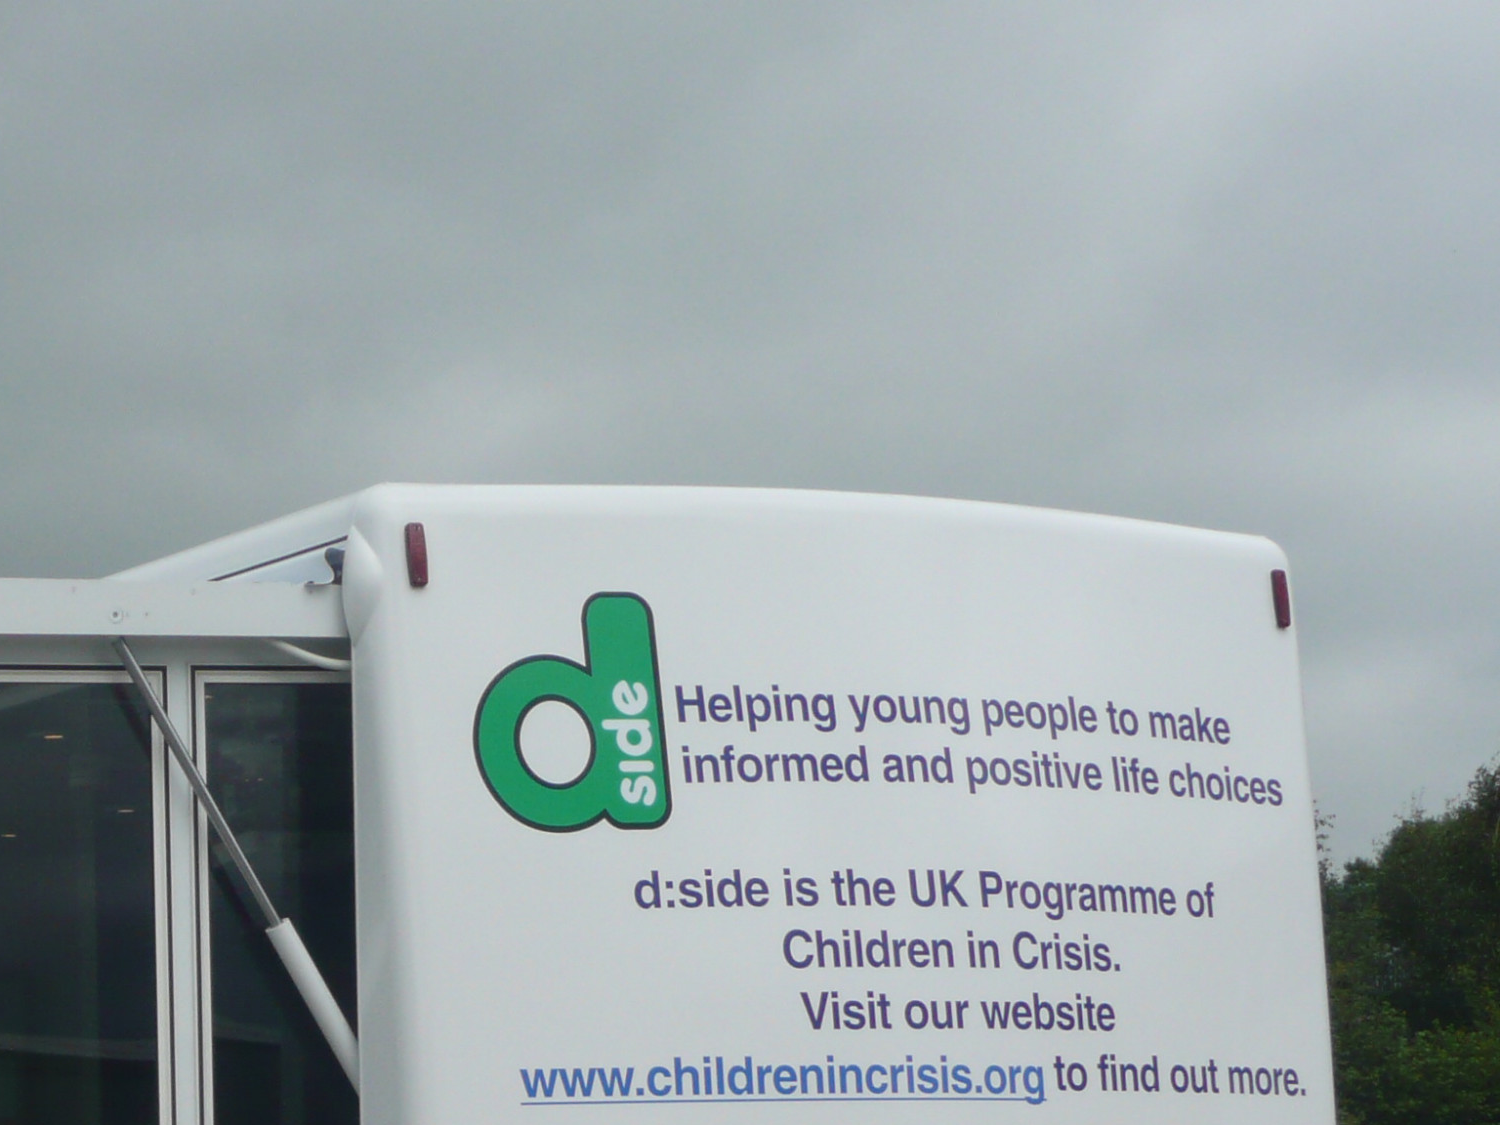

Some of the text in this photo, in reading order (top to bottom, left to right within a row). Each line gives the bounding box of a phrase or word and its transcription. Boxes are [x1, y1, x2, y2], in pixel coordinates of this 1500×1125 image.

[473, 591, 672, 833] d
[675, 684, 1230, 745] Helping young people to make
[601, 679, 657, 807] side
[681, 745, 1284, 807] informed and positive life choices
[634, 868, 1216, 920] d:side is the UK Programme of
[783, 929, 1121, 973] Children in Crisis.
[800, 990, 1115, 1033] Visit our website
[520, 1054, 1307, 1105] www.childrenincrisis.org to find out more.
